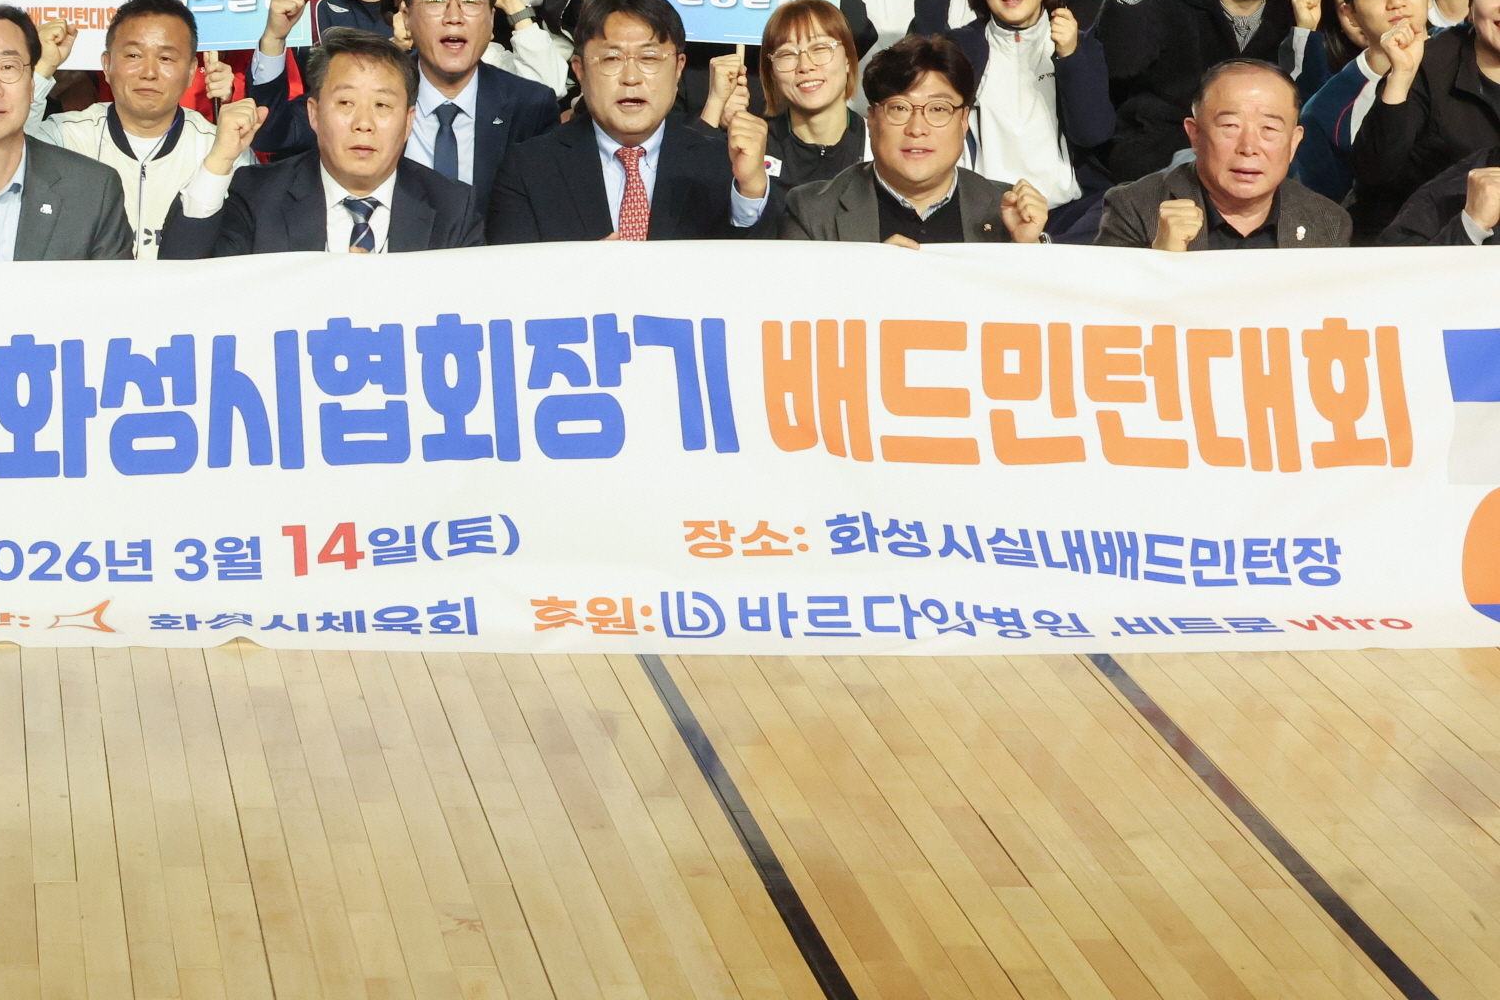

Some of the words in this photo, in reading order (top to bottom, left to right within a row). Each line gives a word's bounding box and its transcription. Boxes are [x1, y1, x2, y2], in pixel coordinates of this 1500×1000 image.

[761, 317, 1414, 474] 배드민턴대회
[174, 536, 263, 582] 3월
[282, 514, 520, 577] 14일(토)
[683, 519, 809, 559] 장소:
[825, 511, 1342, 586] 화성시실내배드민턴장
[148, 596, 479, 636] 화성시체육회
[529, 596, 656, 635] 후원:
